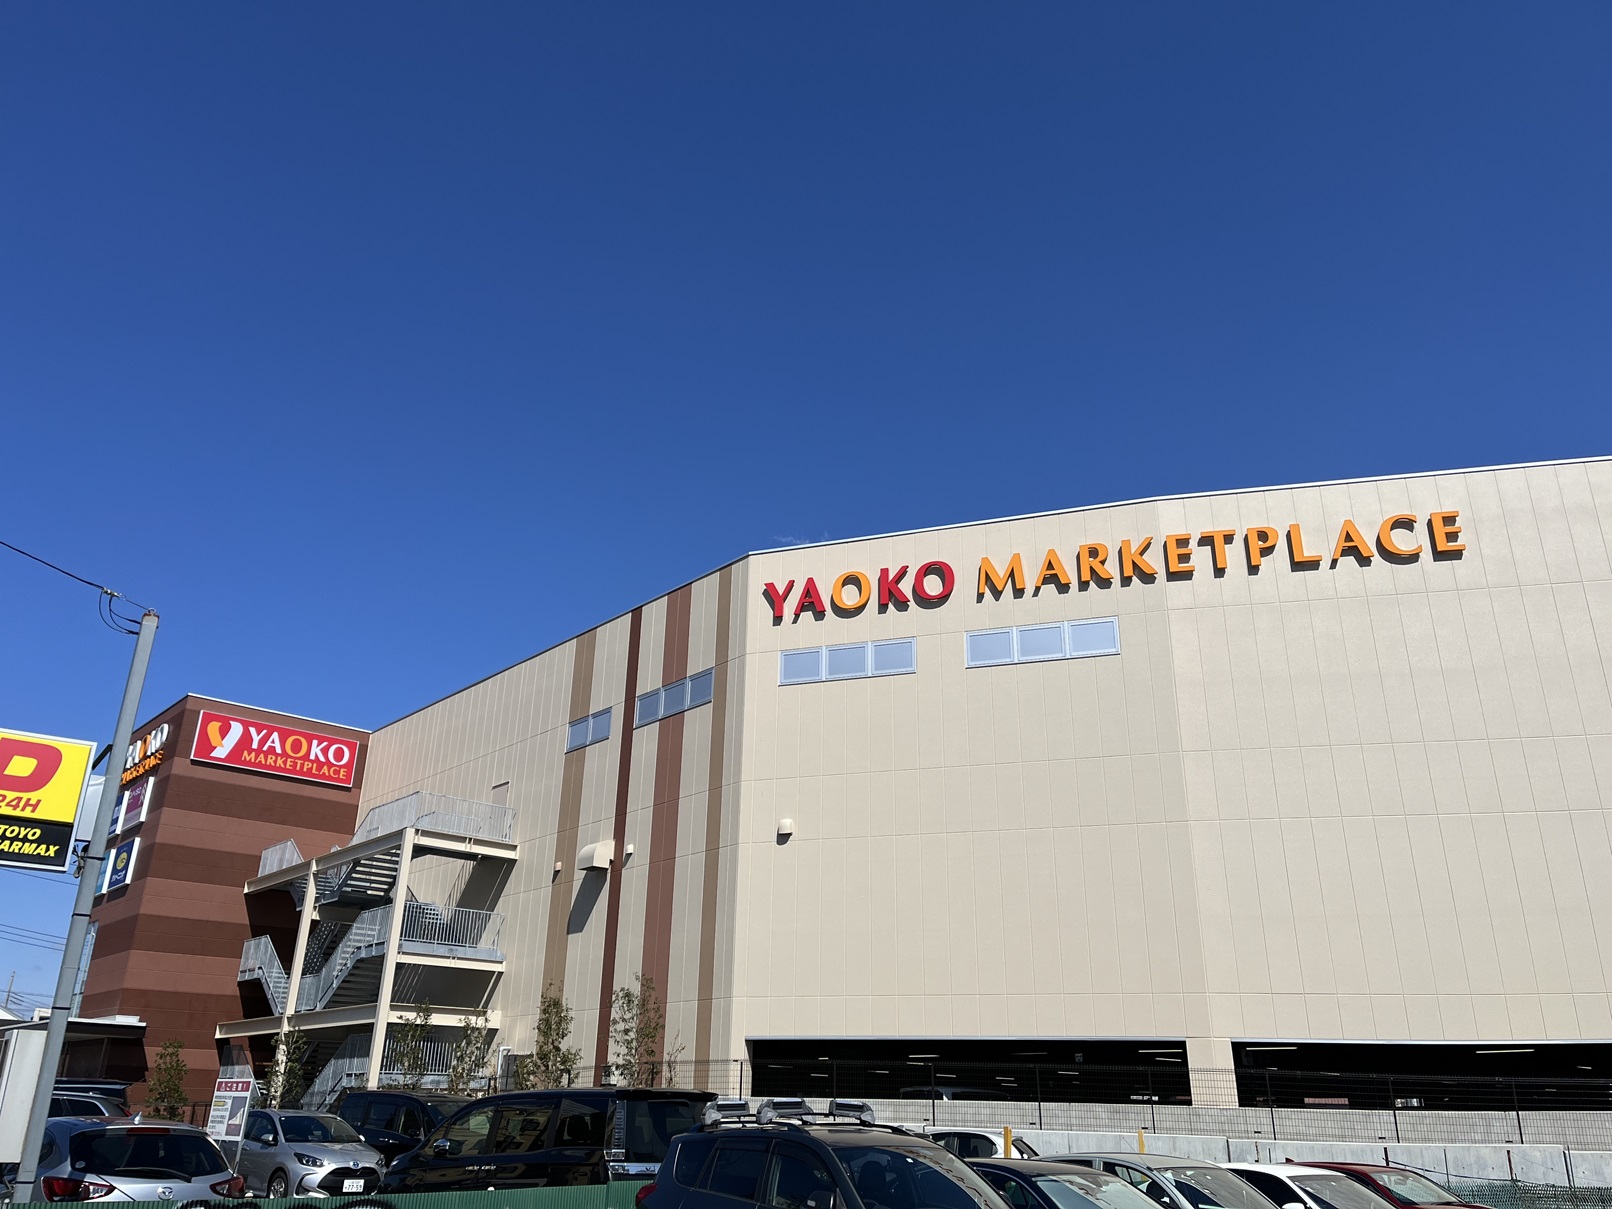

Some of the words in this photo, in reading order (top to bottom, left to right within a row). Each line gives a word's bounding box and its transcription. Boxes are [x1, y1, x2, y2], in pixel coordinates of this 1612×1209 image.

[763, 561, 955, 617] YAOKO
[978, 510, 1467, 596] MARKETPLACE
[0, 737, 63, 793] D
[241, 750, 348, 779] MARKETPLACE
[248, 727, 350, 766] YAOKO
[0, 839, 60, 857] ARMAX
